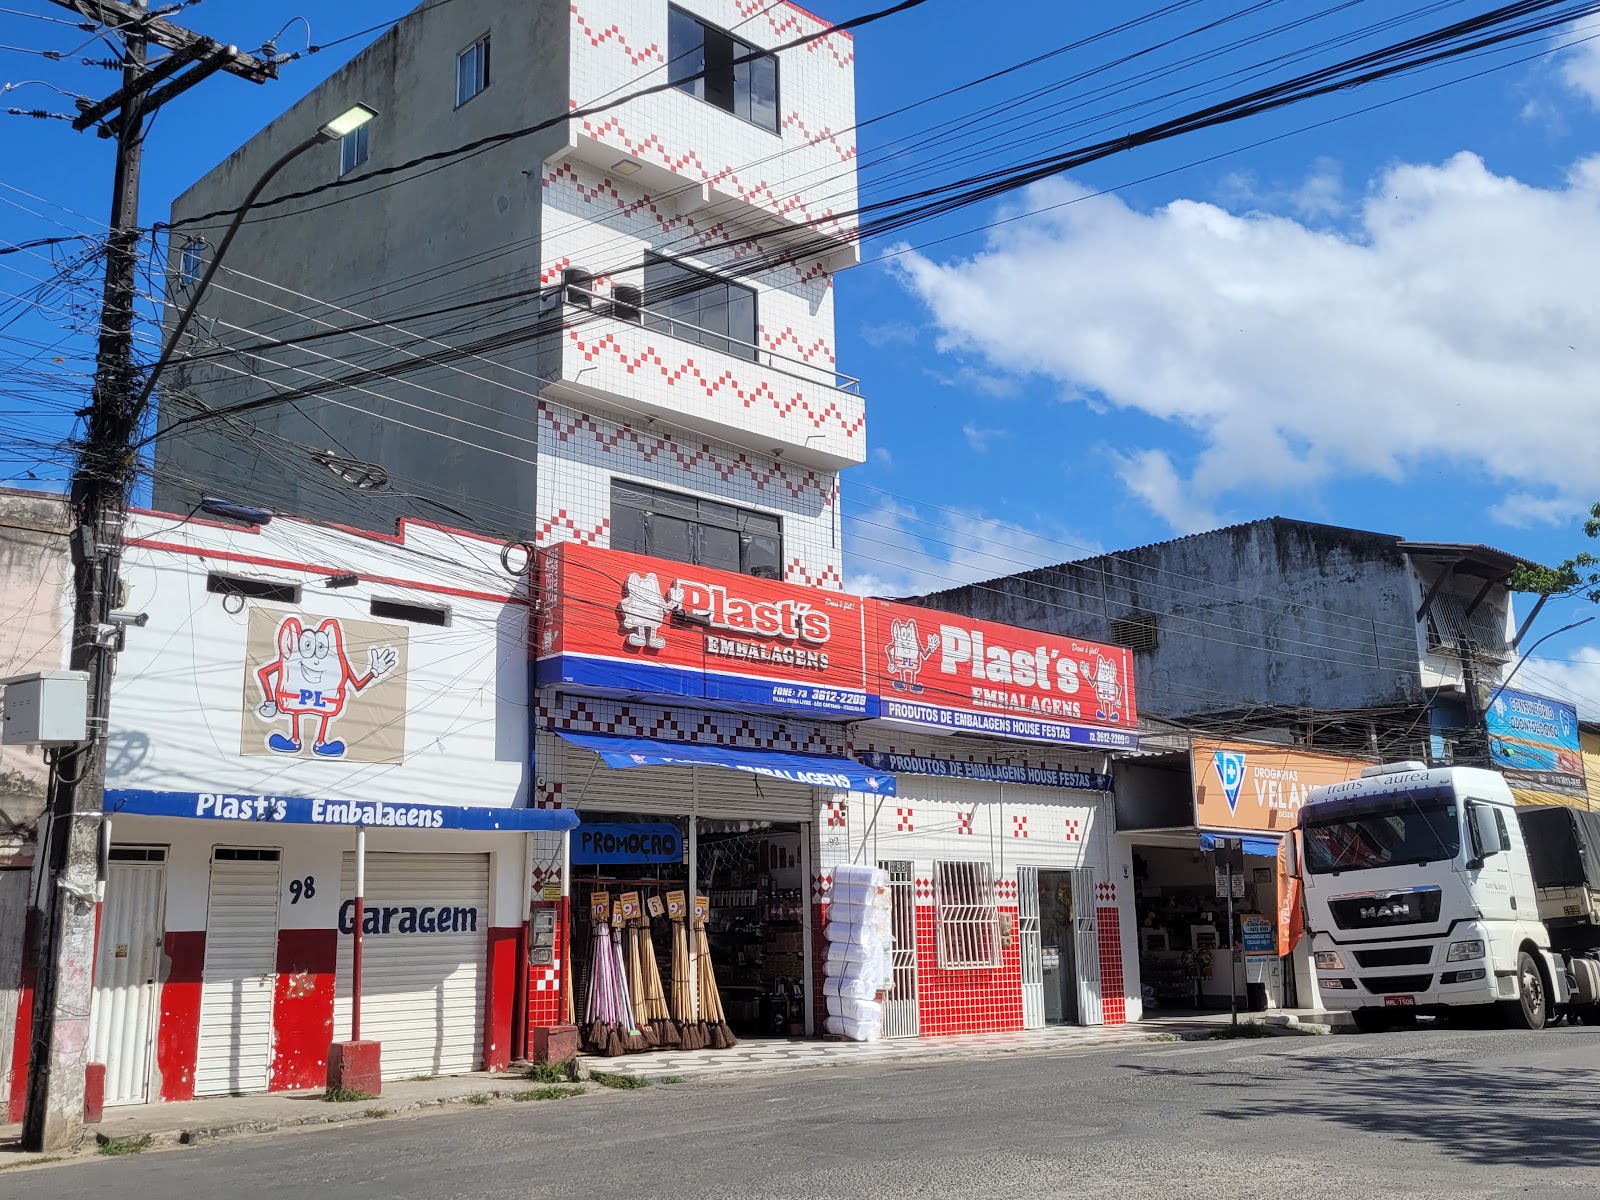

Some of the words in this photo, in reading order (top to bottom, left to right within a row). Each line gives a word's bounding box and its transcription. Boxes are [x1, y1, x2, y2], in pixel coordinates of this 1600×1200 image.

[674, 578, 831, 644] Plast's
[707, 636, 829, 669] EMBALAGENS
[940, 624, 1079, 694] Plast's
[299, 688, 327, 708] PL
[773, 687, 796, 697] FONE:
[797, 689, 808, 698] 73
[971, 686, 1081, 718] EMBALAGENS
[889, 702, 938, 720] PRODUTOS
[941, 710, 952, 724] DE
[954, 712, 1011, 732] EMBALAGENS
[1012, 720, 1040, 736] HOUSE
[1042, 725, 1071, 740] FESTAS
[889, 755, 946, 775] PRODUTOS
[949, 762, 964, 776] DE
[964, 763, 1026, 782] EMBALAGENS
[1027, 768, 1058, 785] HOUSE
[1060, 773, 1090, 788] FESTAS
[1254, 767, 1298, 782] DROGARIAS
[1324, 785, 1429, 803] TRANSPORTES
[1327, 781, 1364, 795] trans
[196, 793, 287, 821] Plast's
[312, 799, 443, 828] Embalagens
[582, 830, 676, 861] PROMOÇÃO
[289, 875, 316, 905] 98
[338, 899, 478, 935] Garagem
[1360, 904, 1410, 919] MAN
